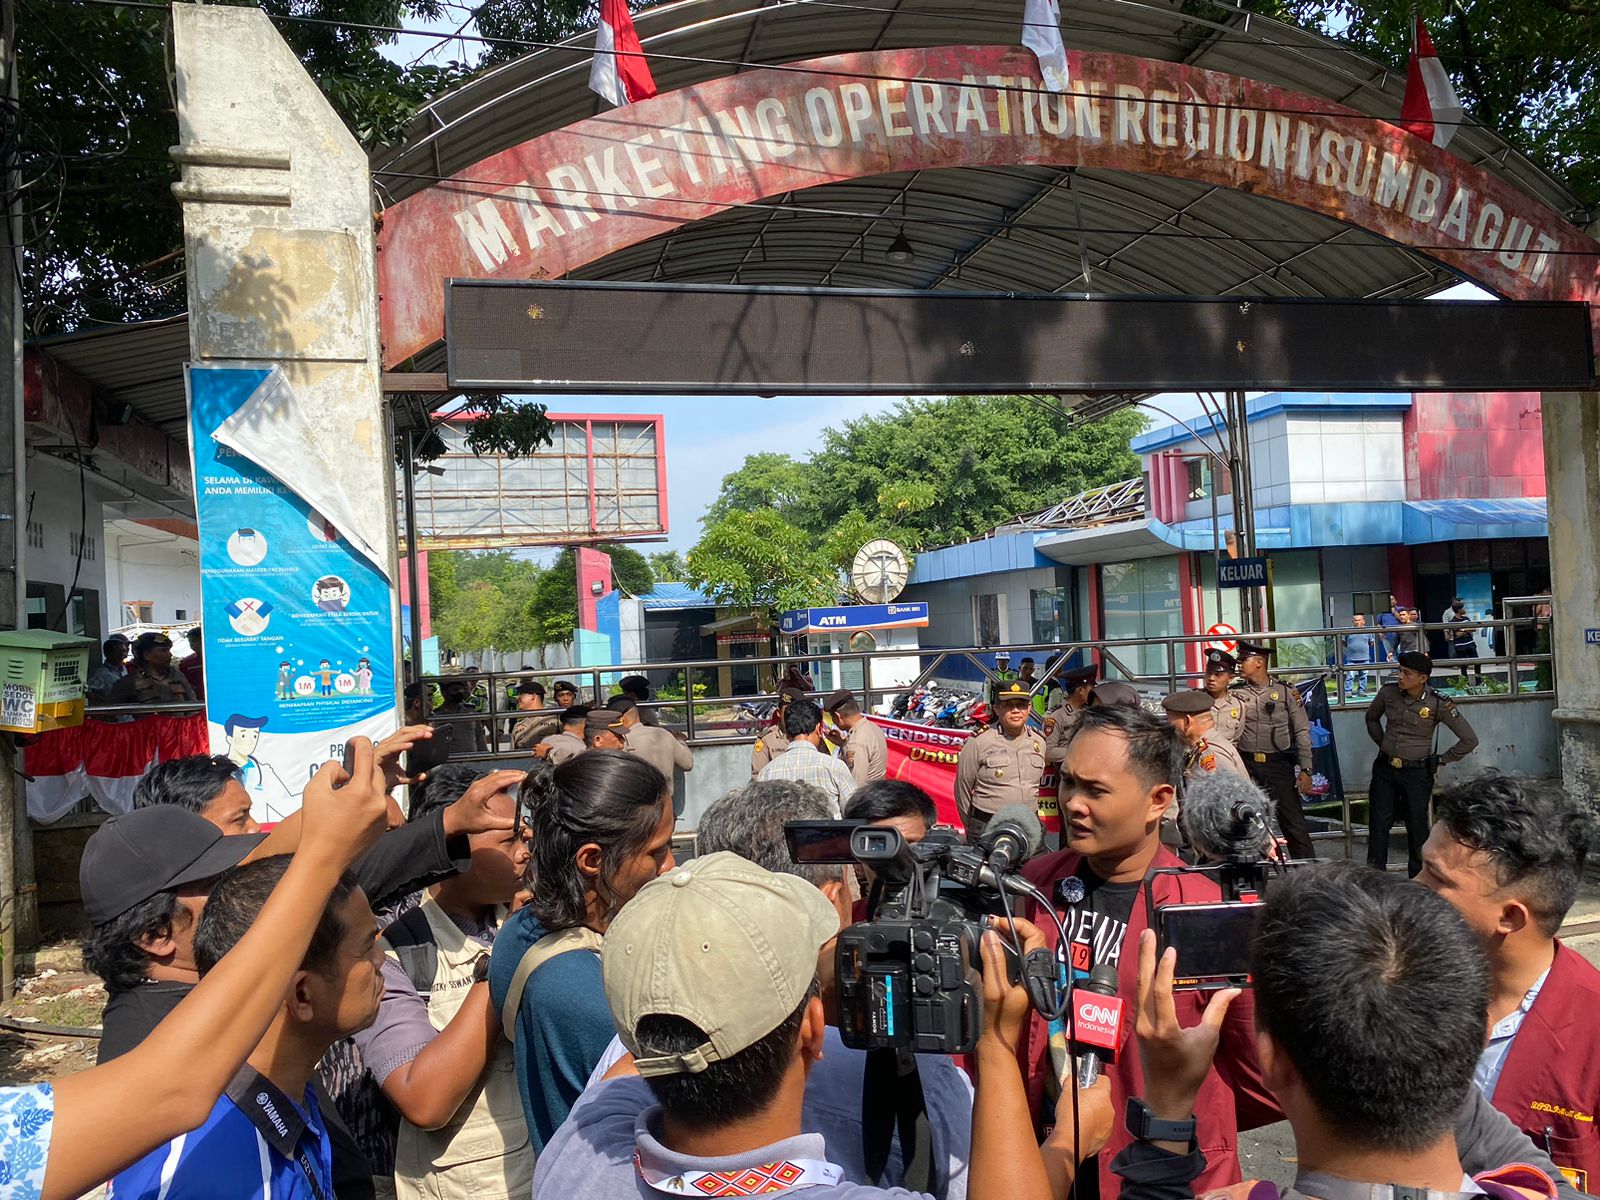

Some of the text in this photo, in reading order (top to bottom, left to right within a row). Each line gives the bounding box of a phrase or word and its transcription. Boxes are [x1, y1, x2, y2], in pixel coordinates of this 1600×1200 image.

[453, 97, 797, 273] MARKETING
[806, 74, 1101, 149] OPERATION
[1117, 84, 1290, 171] REGION
[1316, 127, 1560, 284] SUMBAGUT
[204, 476, 240, 485] SELAMA
[204, 487, 234, 495] ANDA
[1220, 563, 1264, 581] KELUAR
[819, 615, 847, 626] ATM
[298, 682, 312, 690] 1M
[338, 679, 352, 687] 1M
[3, 690, 34, 700] SEDOT
[3, 698, 34, 713] WC
[881, 727, 968, 746] ENDESA
[909, 747, 961, 764] Untu
[1072, 945, 1088, 967] 19
[1080, 1003, 1118, 1026] CNN
[1077, 1019, 1116, 1036] Indonesia
[262, 1100, 289, 1138] YAMAHA
